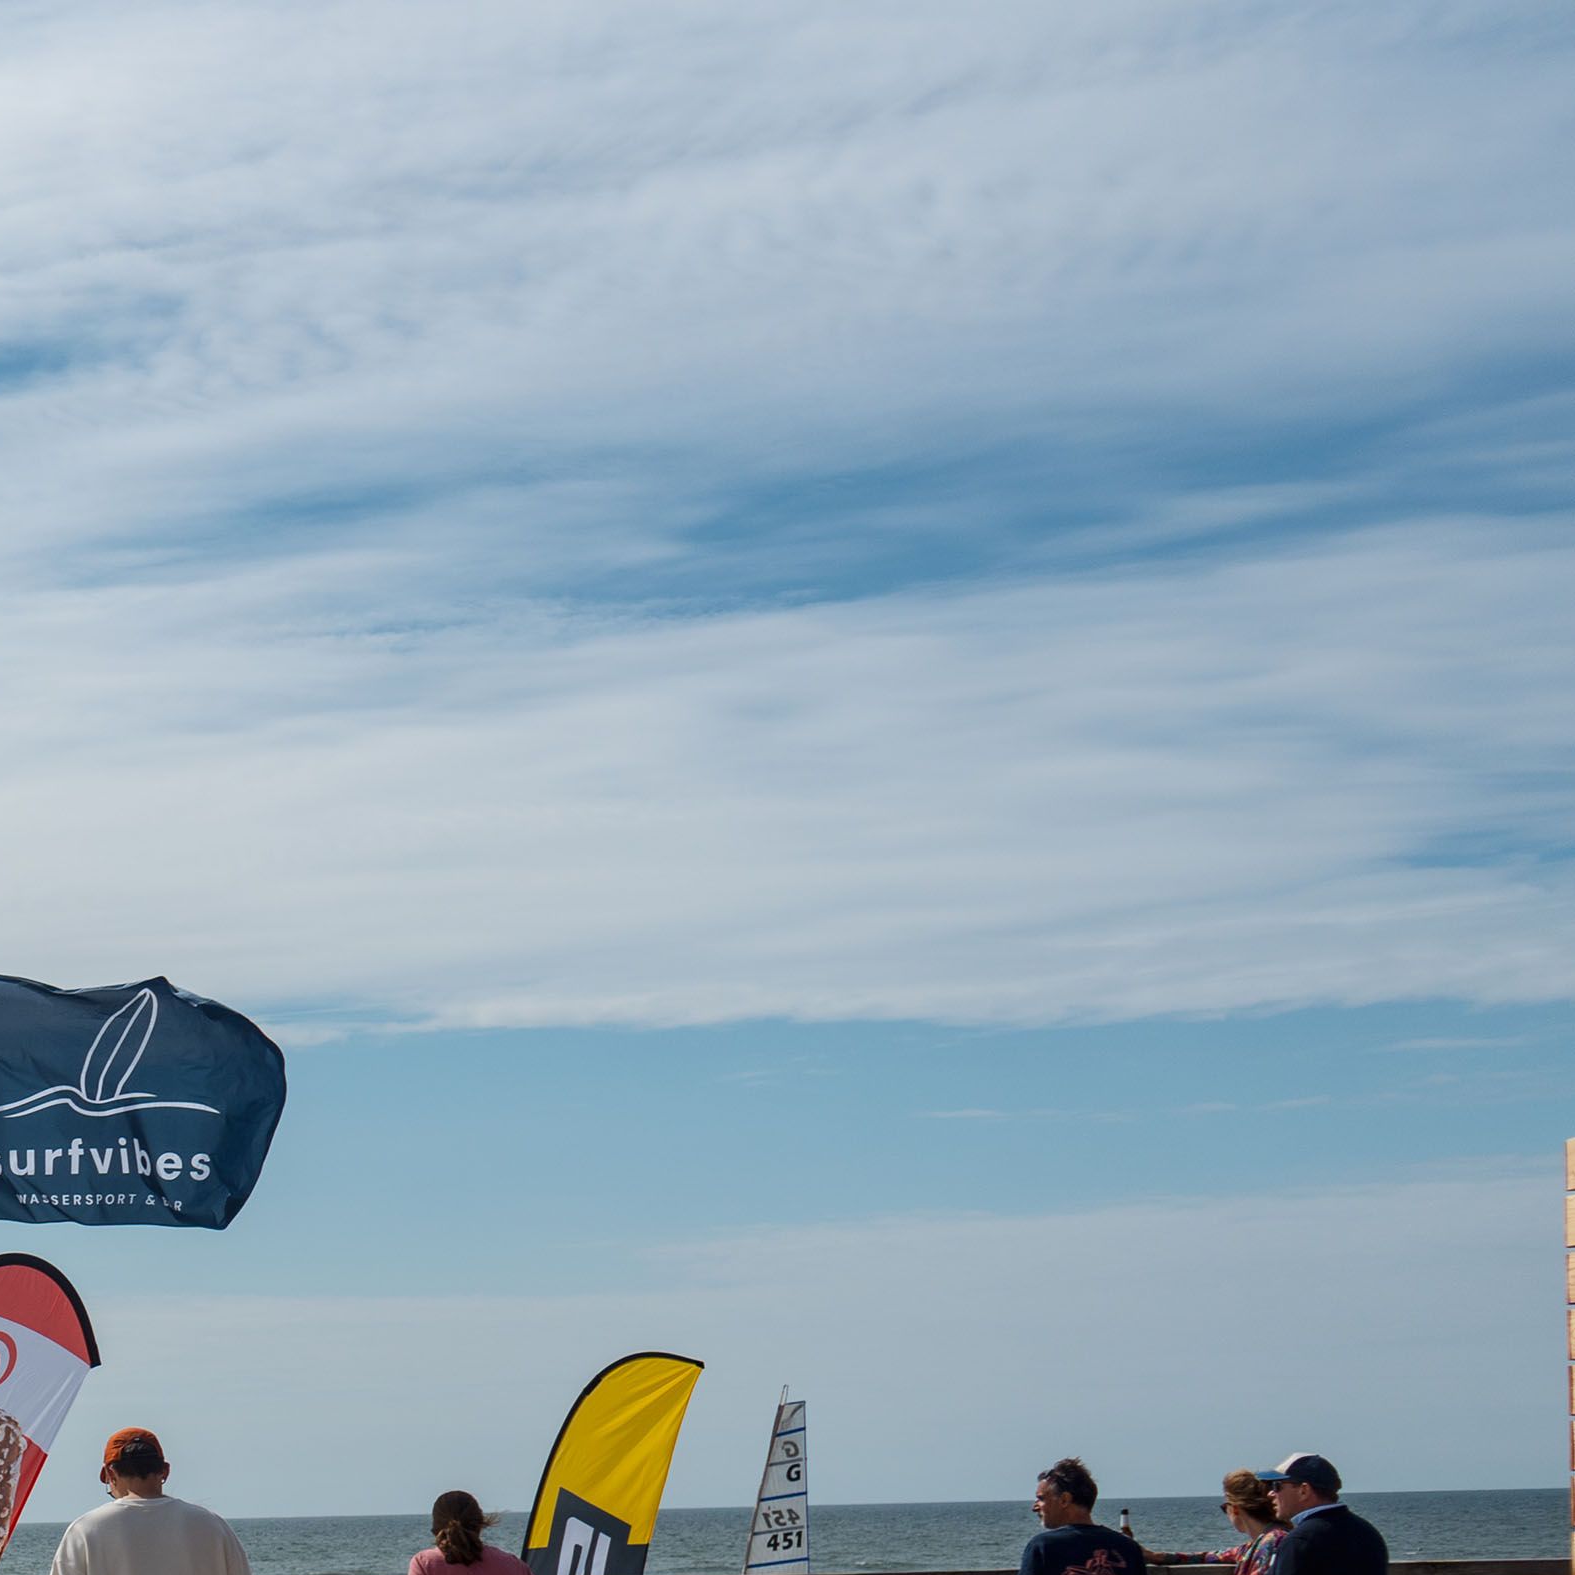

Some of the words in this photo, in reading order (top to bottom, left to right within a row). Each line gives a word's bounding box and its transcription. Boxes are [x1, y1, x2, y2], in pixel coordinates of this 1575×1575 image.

[145, 1194, 156, 1206] &
[786, 1463, 801, 1482] G
[766, 1530, 803, 1551] 451
